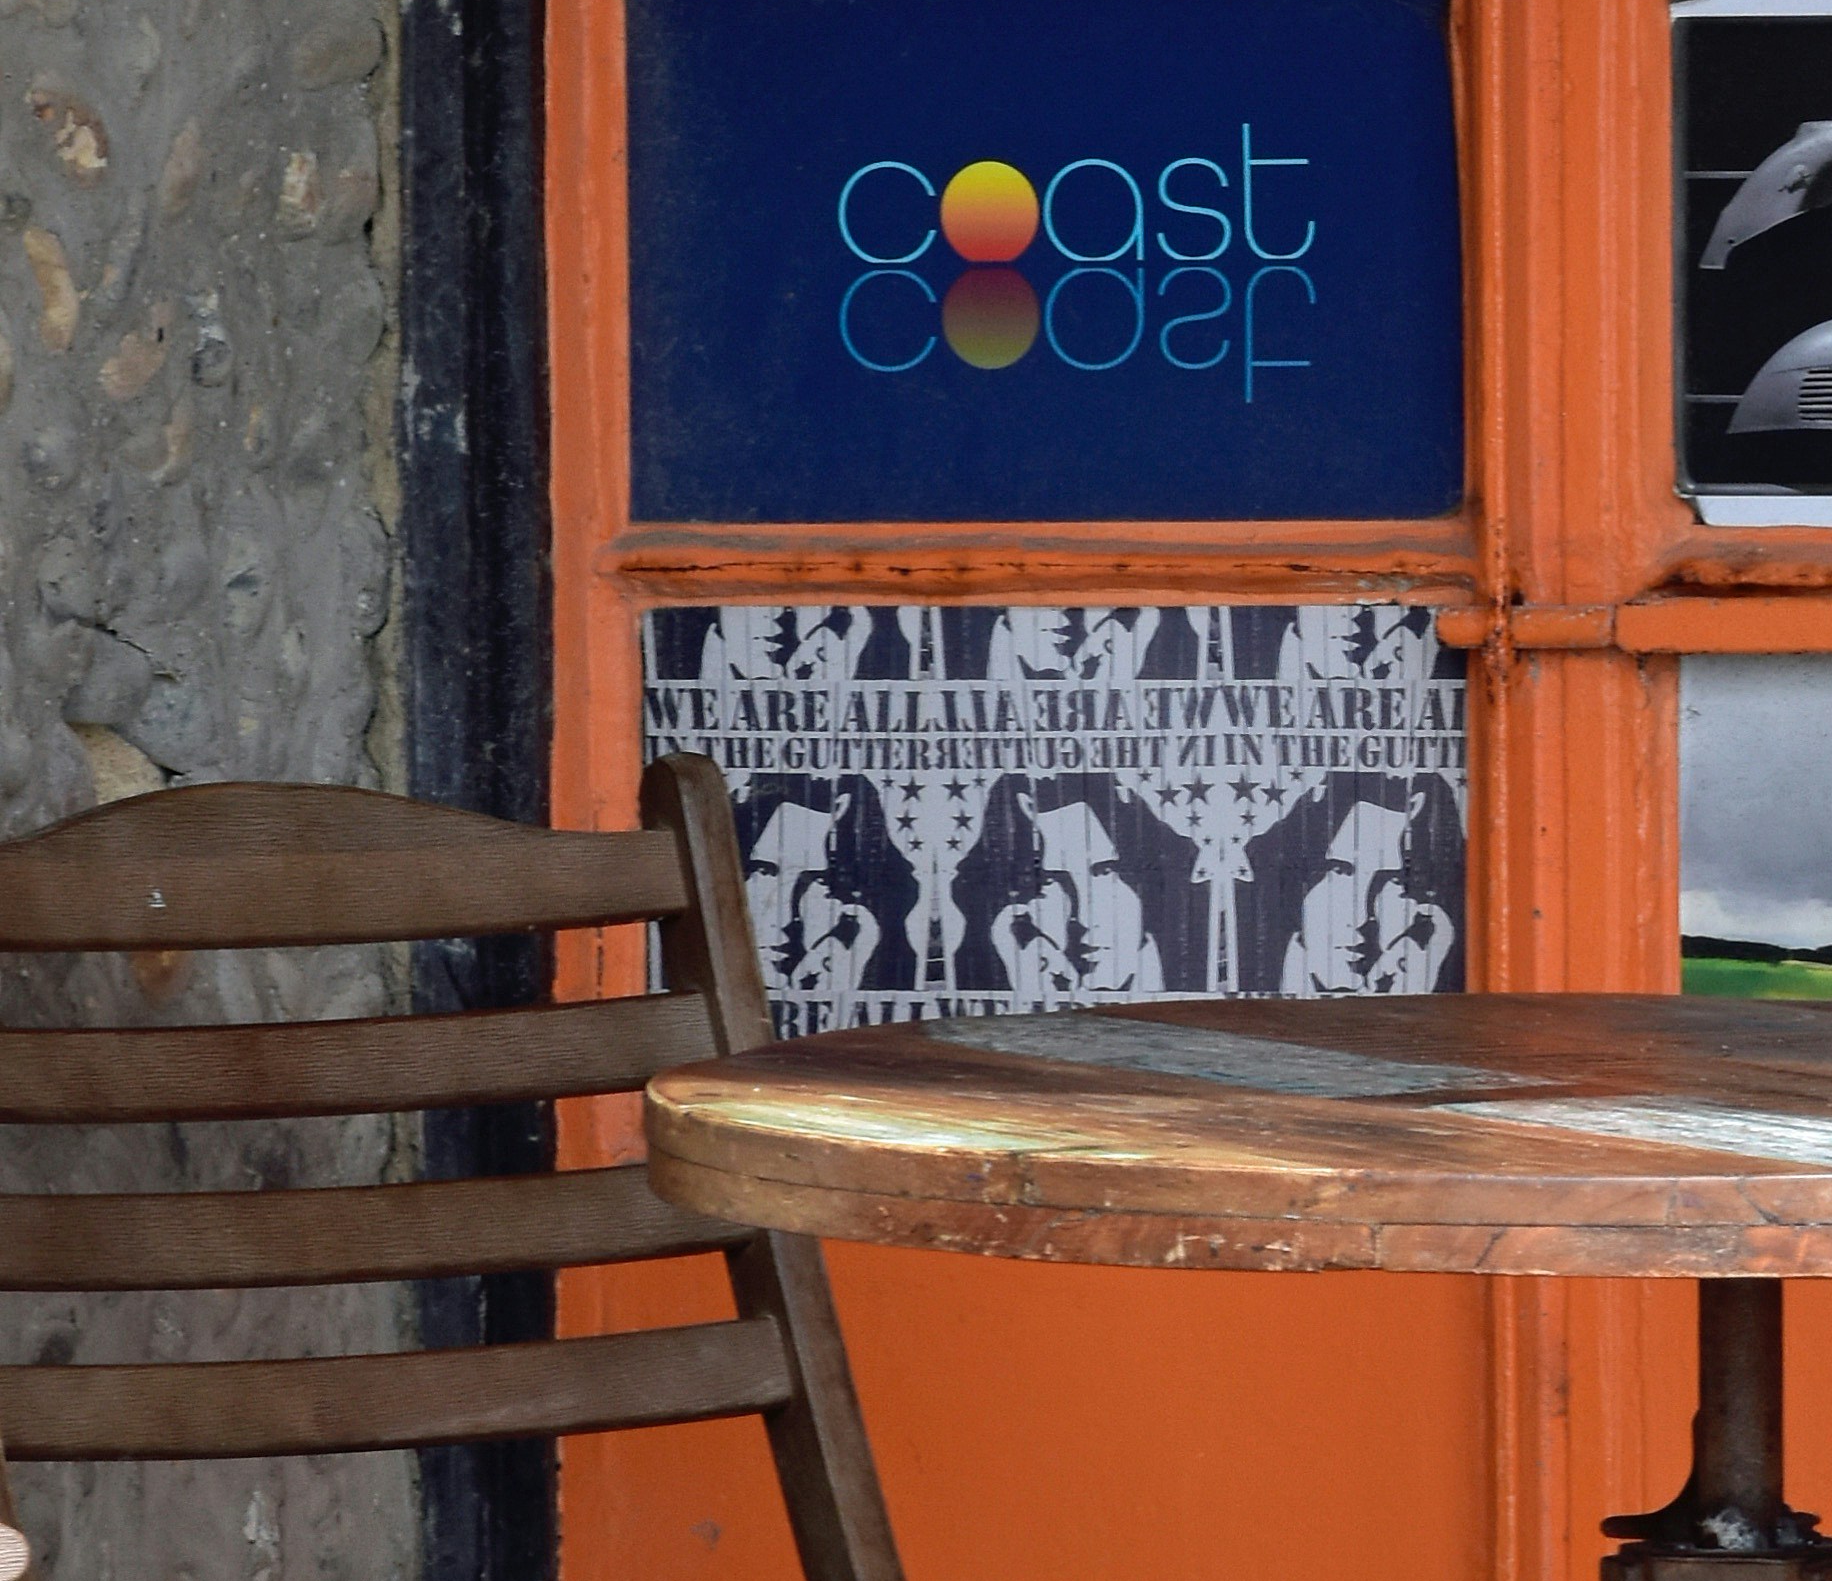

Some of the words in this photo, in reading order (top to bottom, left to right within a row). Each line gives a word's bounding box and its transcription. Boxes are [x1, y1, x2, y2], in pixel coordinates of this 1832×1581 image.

[837, 123, 1316, 264] coast
[644, 687, 721, 732] WE
[730, 688, 830, 733] ARE
[841, 689, 930, 733] ALL
[1306, 685, 1406, 731] ARE
[781, 737, 931, 771] GUTTER
[1271, 735, 1351, 768] THE
[768, 1000, 836, 1042] RE
